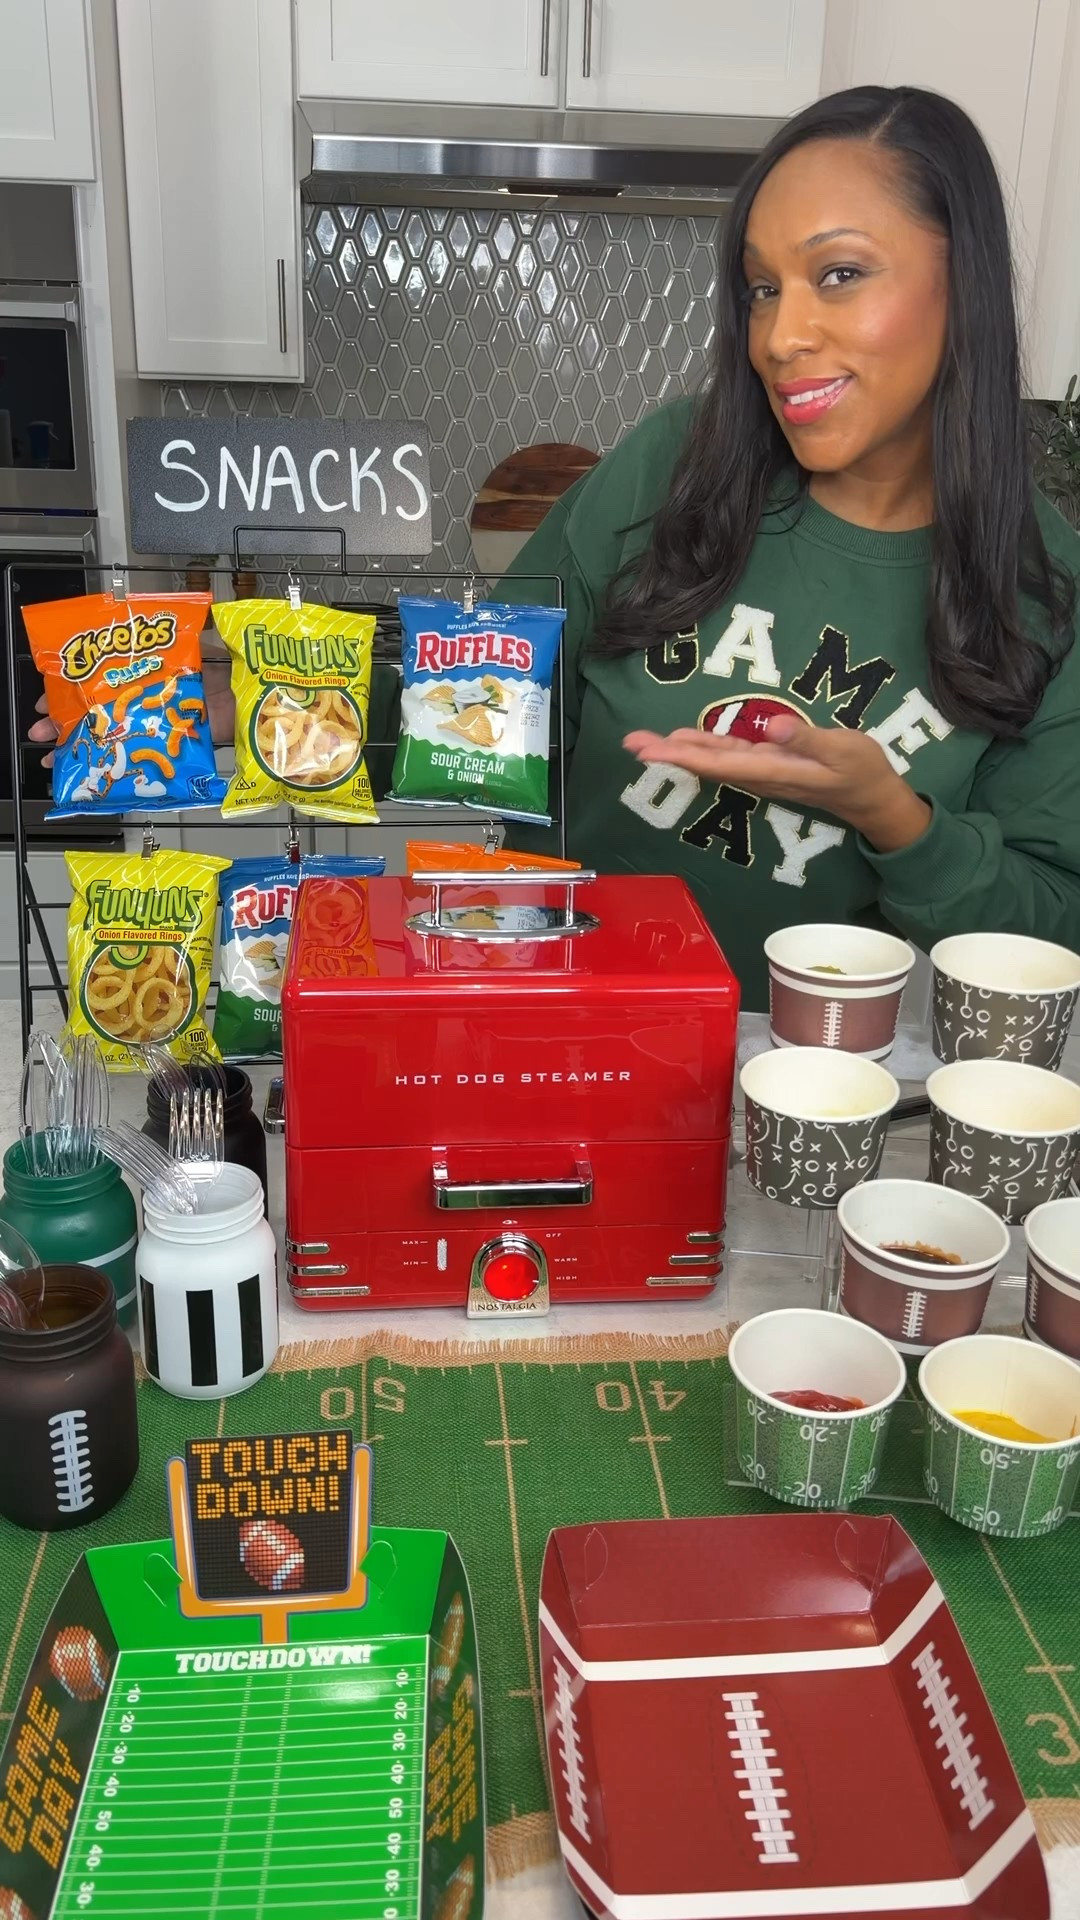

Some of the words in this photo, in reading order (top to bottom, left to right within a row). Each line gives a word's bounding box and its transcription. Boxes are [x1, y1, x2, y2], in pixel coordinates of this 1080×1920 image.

[154, 439, 430, 521] SNACKS
[60, 615, 176, 681] Cheetos
[415, 631, 533, 673] RUFFLES
[265, 670, 288, 681] Onion
[289, 675, 322, 686] Flavored
[324, 676, 347, 687] Rings
[644, 603, 955, 775] GAME
[430, 752, 461, 769] SOUR
[464, 756, 505, 775] CREAM
[448, 769, 454, 780] &
[457, 770, 485, 785] ONION
[619, 761, 847, 888] DAY
[99, 930, 120, 939] Onion
[123, 931, 158, 940] Flavored
[160, 932, 182, 942] Rings
[189, 1031, 204, 1042] 100
[396, 1075, 442, 1085] HOT
[456, 1073, 505, 1084] DOG
[520, 1071, 631, 1083] STEAMER
[478, 1302, 536, 1311] NOSTALGIA
[191, 1435, 347, 1479] TOUCH
[197, 1475, 339, 1519] DOWN!
[175, 1644, 371, 1673] TOUCHDOWN!
[29, 1738, 81, 1869] DAY
